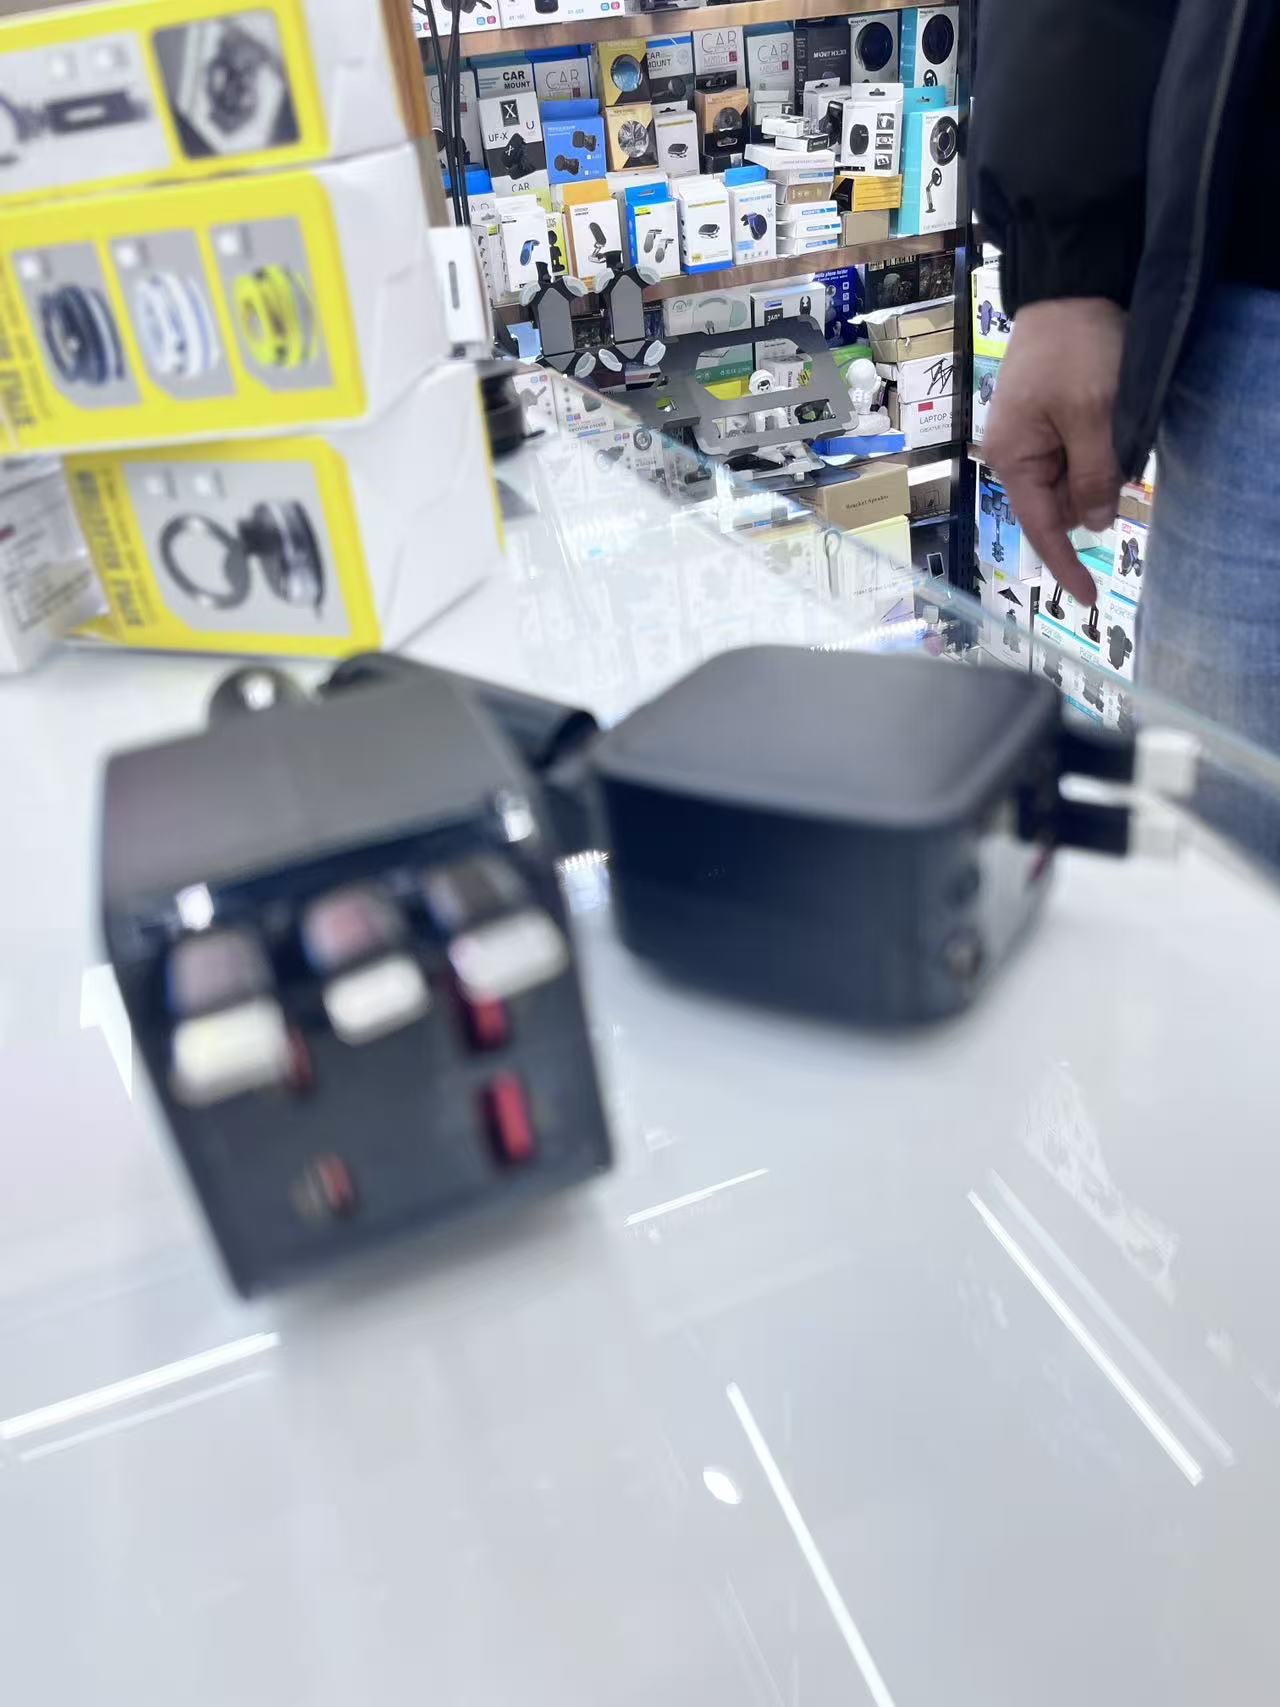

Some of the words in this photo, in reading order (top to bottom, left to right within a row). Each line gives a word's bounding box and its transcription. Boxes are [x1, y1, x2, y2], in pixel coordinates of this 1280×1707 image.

[701, 30, 737, 54] CAR
[757, 42, 789, 63] CAR
[502, 70, 526, 81] CAR
[545, 68, 580, 90] CAR
[503, 80, 530, 90] MOUNT
[504, 103, 517, 119] X
[488, 132, 509, 143] UF-X
[511, 181, 530, 193] CAR
[919, 412, 948, 425] LAPTOP
